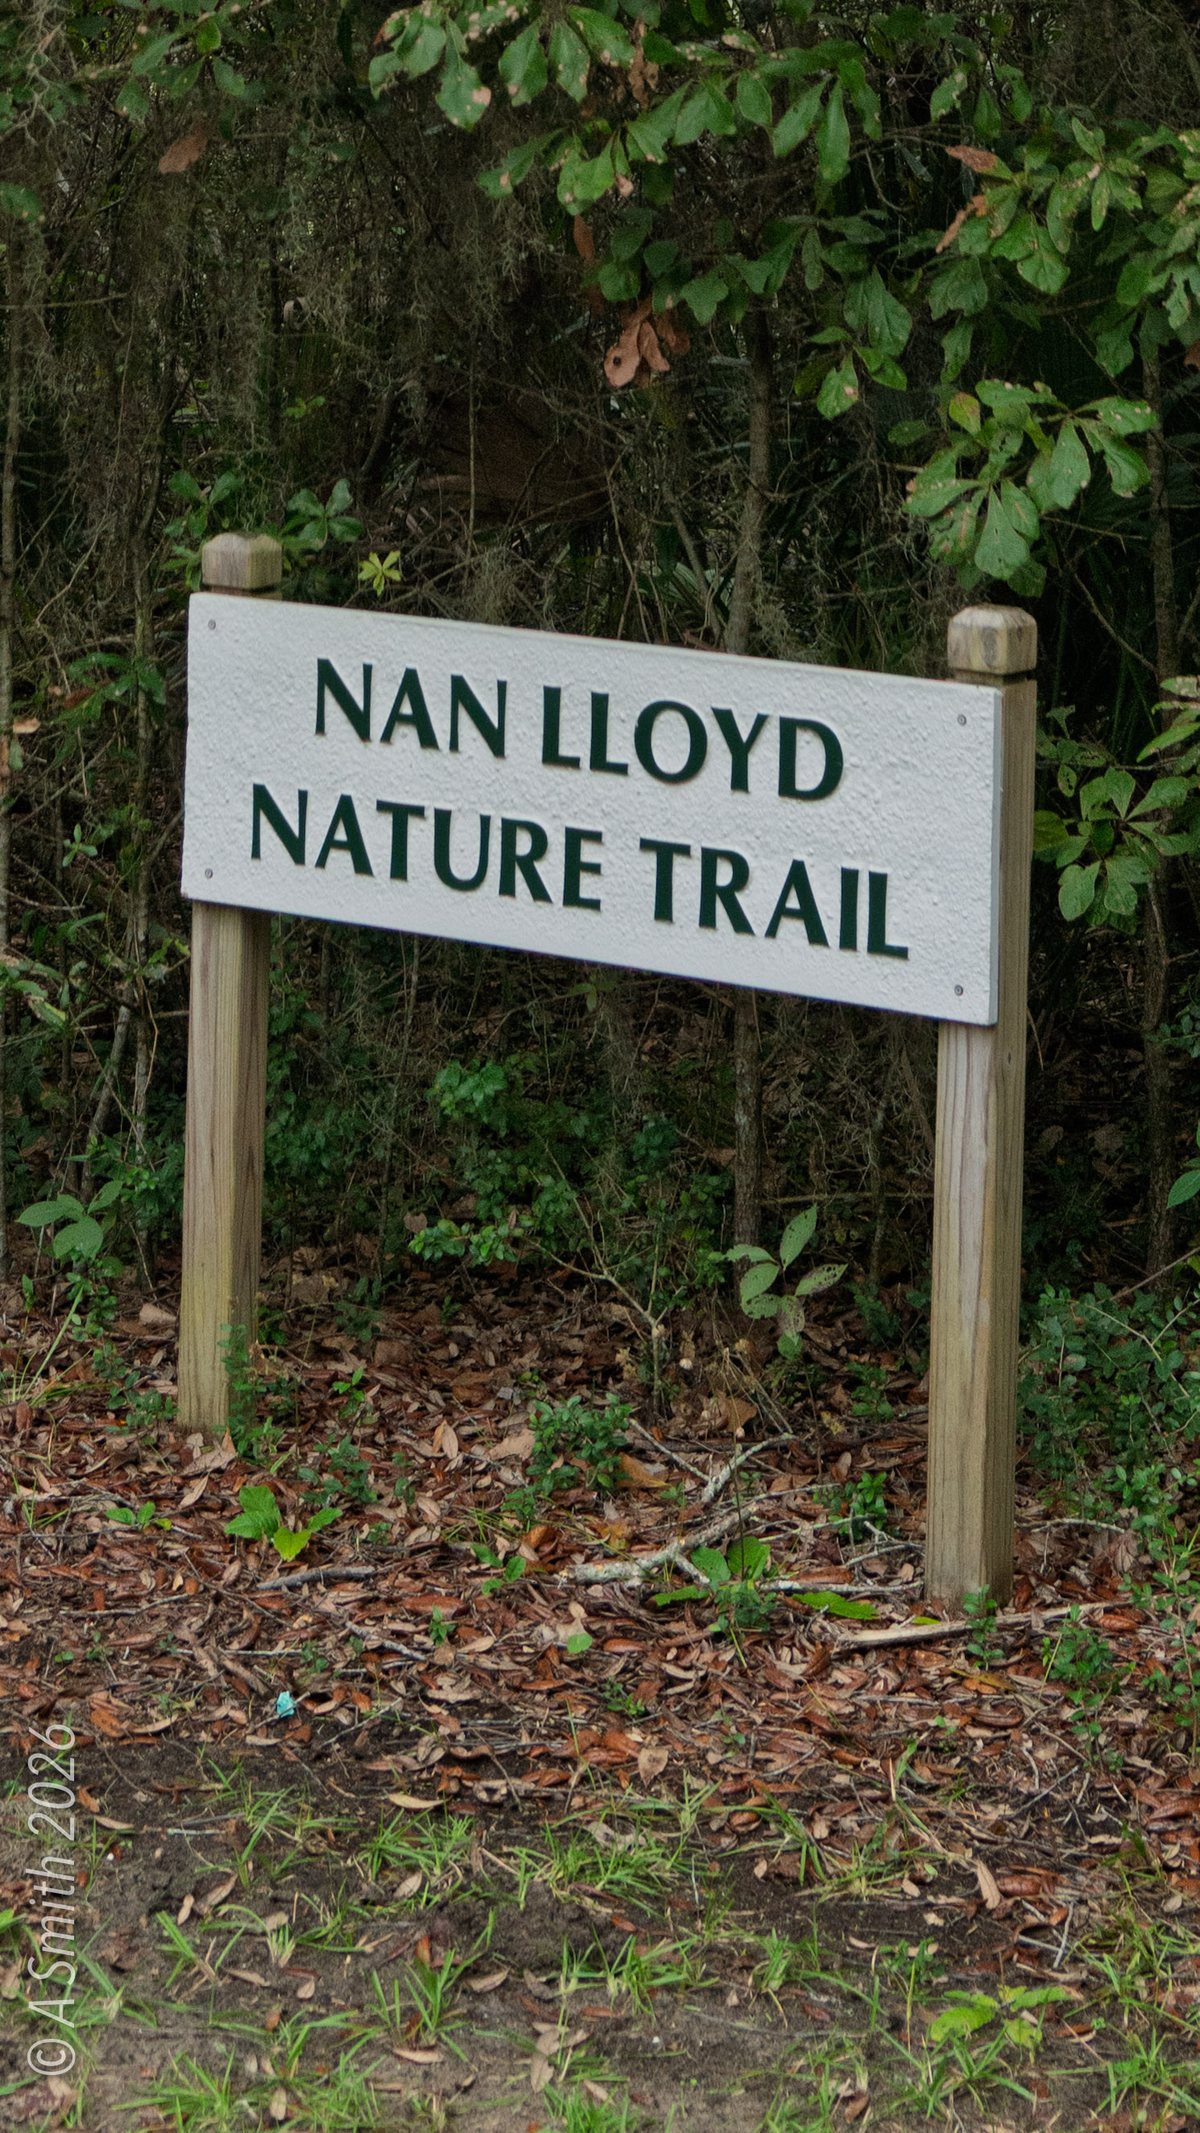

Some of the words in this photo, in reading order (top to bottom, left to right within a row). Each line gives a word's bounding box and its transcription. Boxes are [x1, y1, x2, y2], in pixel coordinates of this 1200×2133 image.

[315, 657, 509, 760] NAN
[541, 685, 845, 802] LLOYD
[250, 782, 604, 913] NATURE
[639, 837, 910, 961] TRAIL
